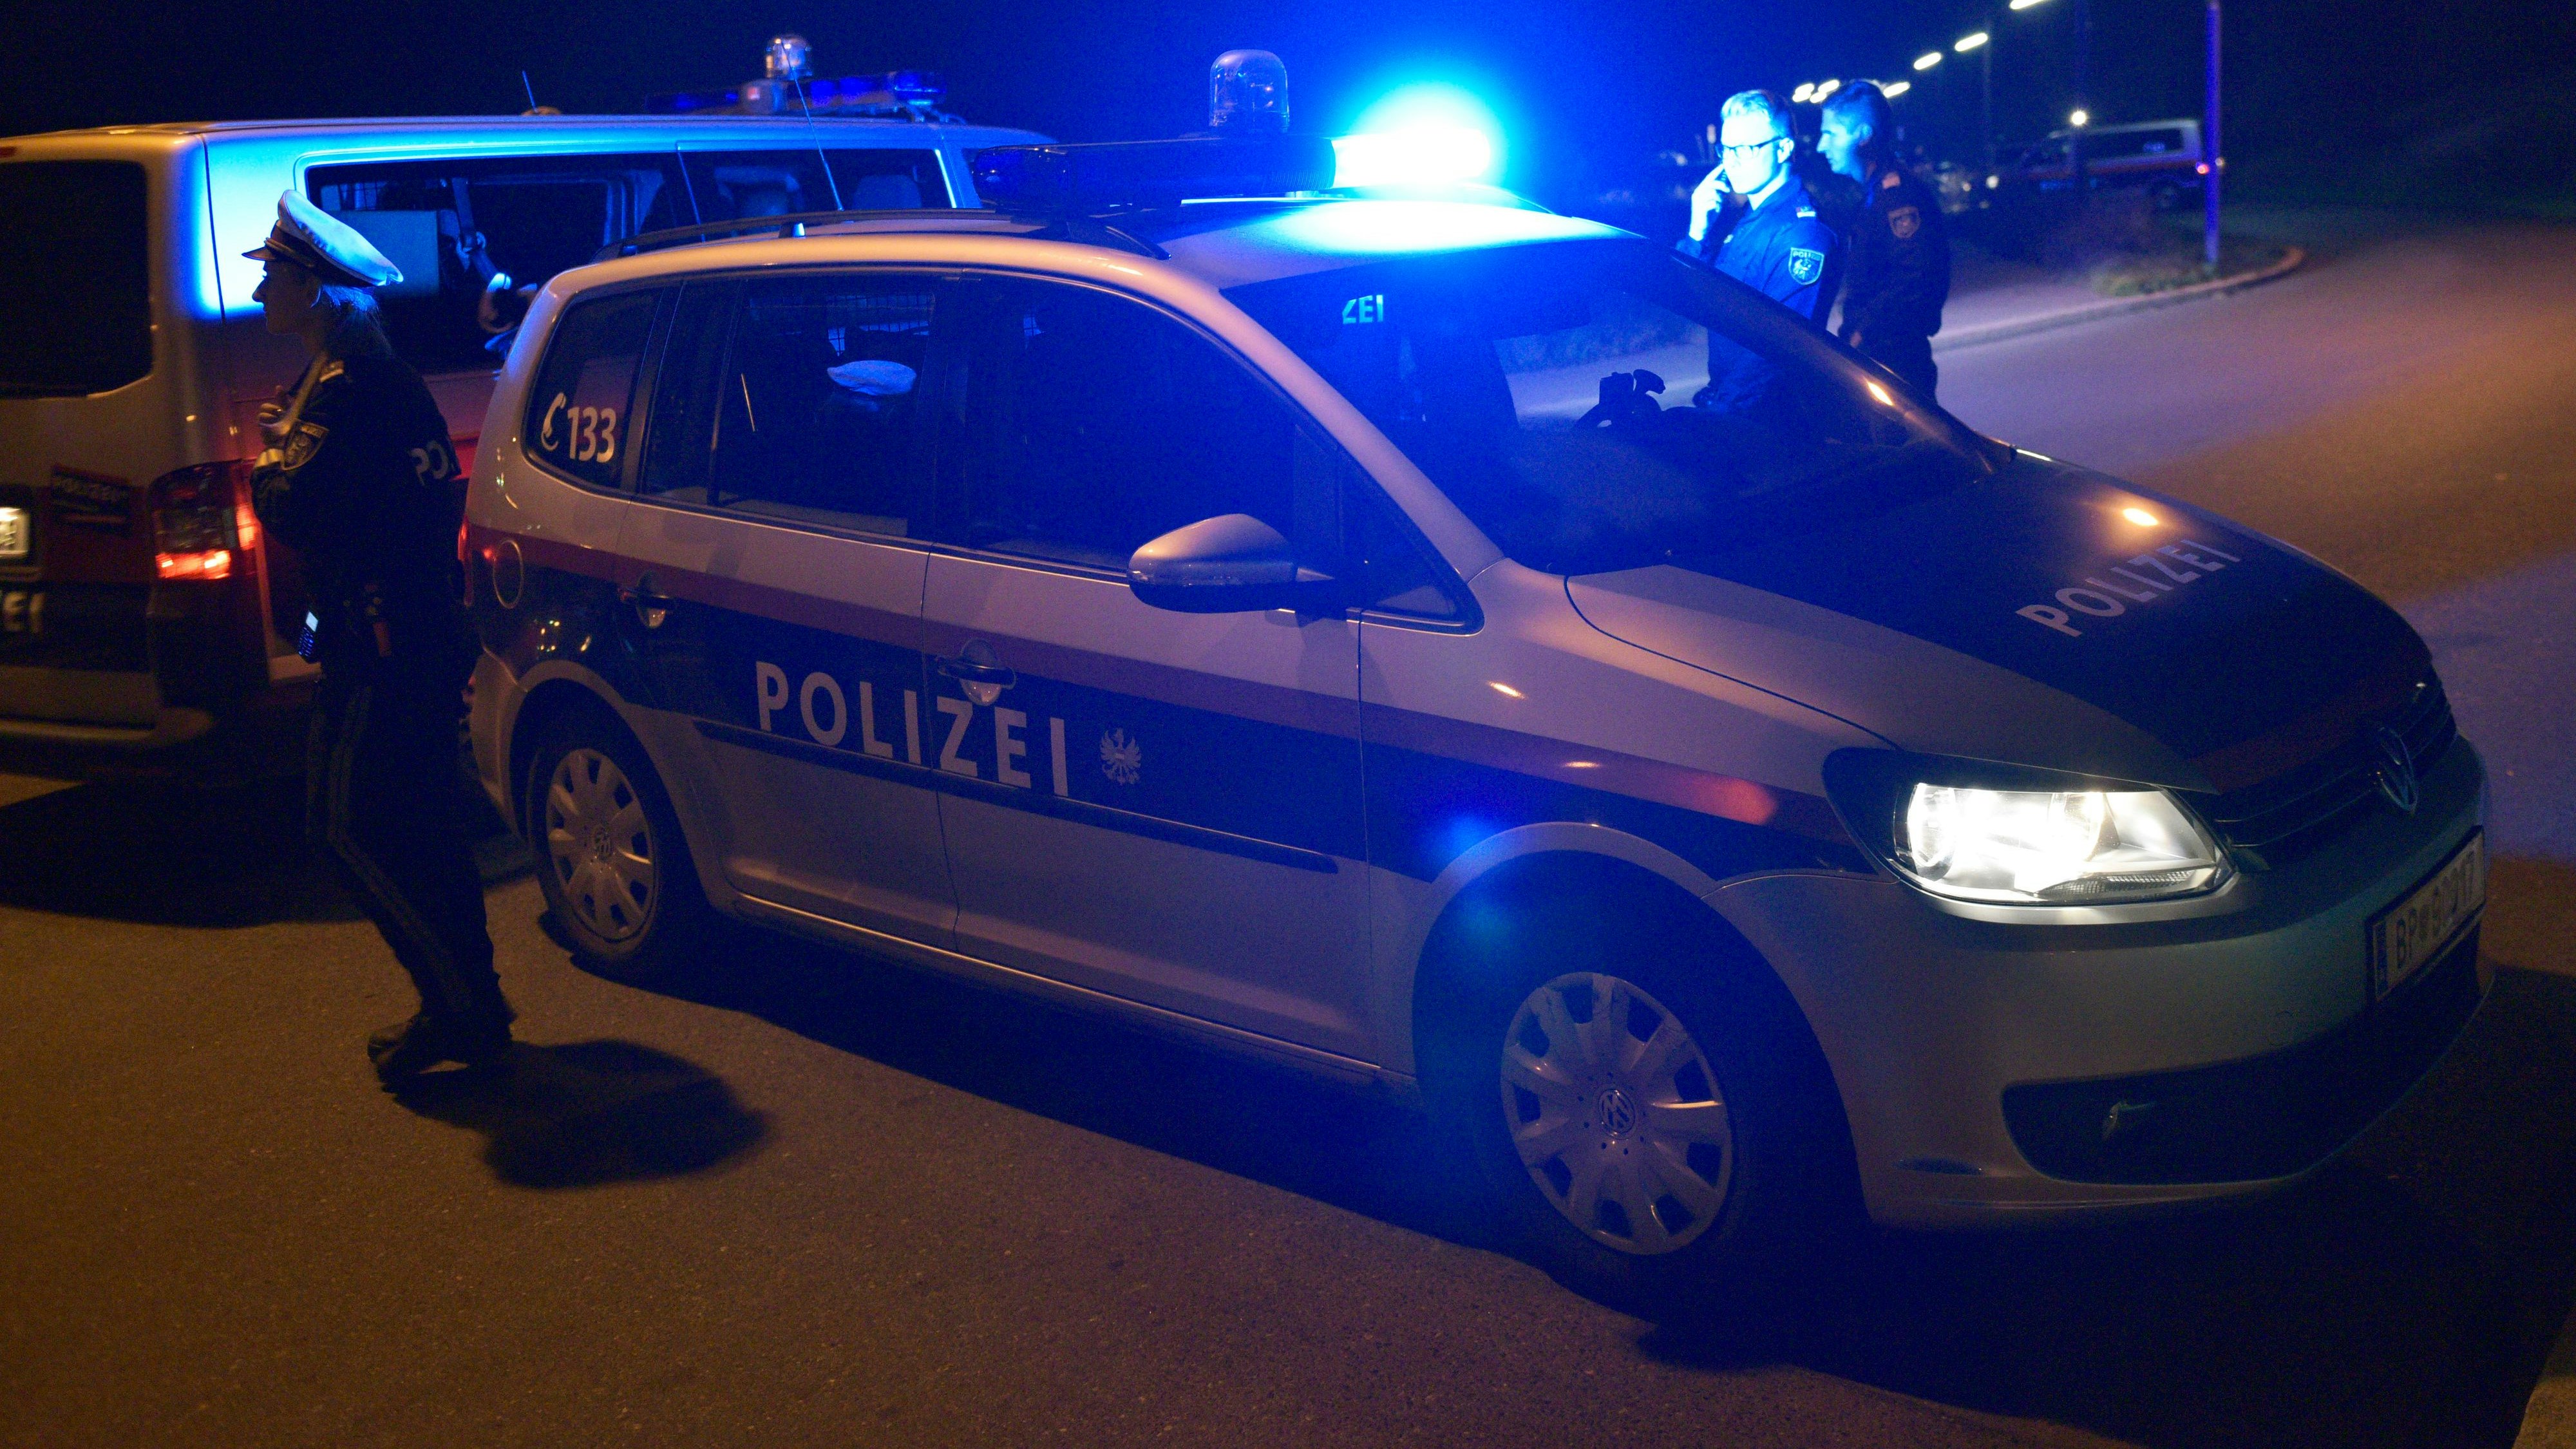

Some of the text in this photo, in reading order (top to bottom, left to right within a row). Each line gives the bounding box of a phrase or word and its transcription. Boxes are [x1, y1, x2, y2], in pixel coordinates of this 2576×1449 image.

[567, 406, 616, 463] 133
[2014, 539, 2241, 638] POLIZEI
[755, 661, 1069, 797] POLIZEI
